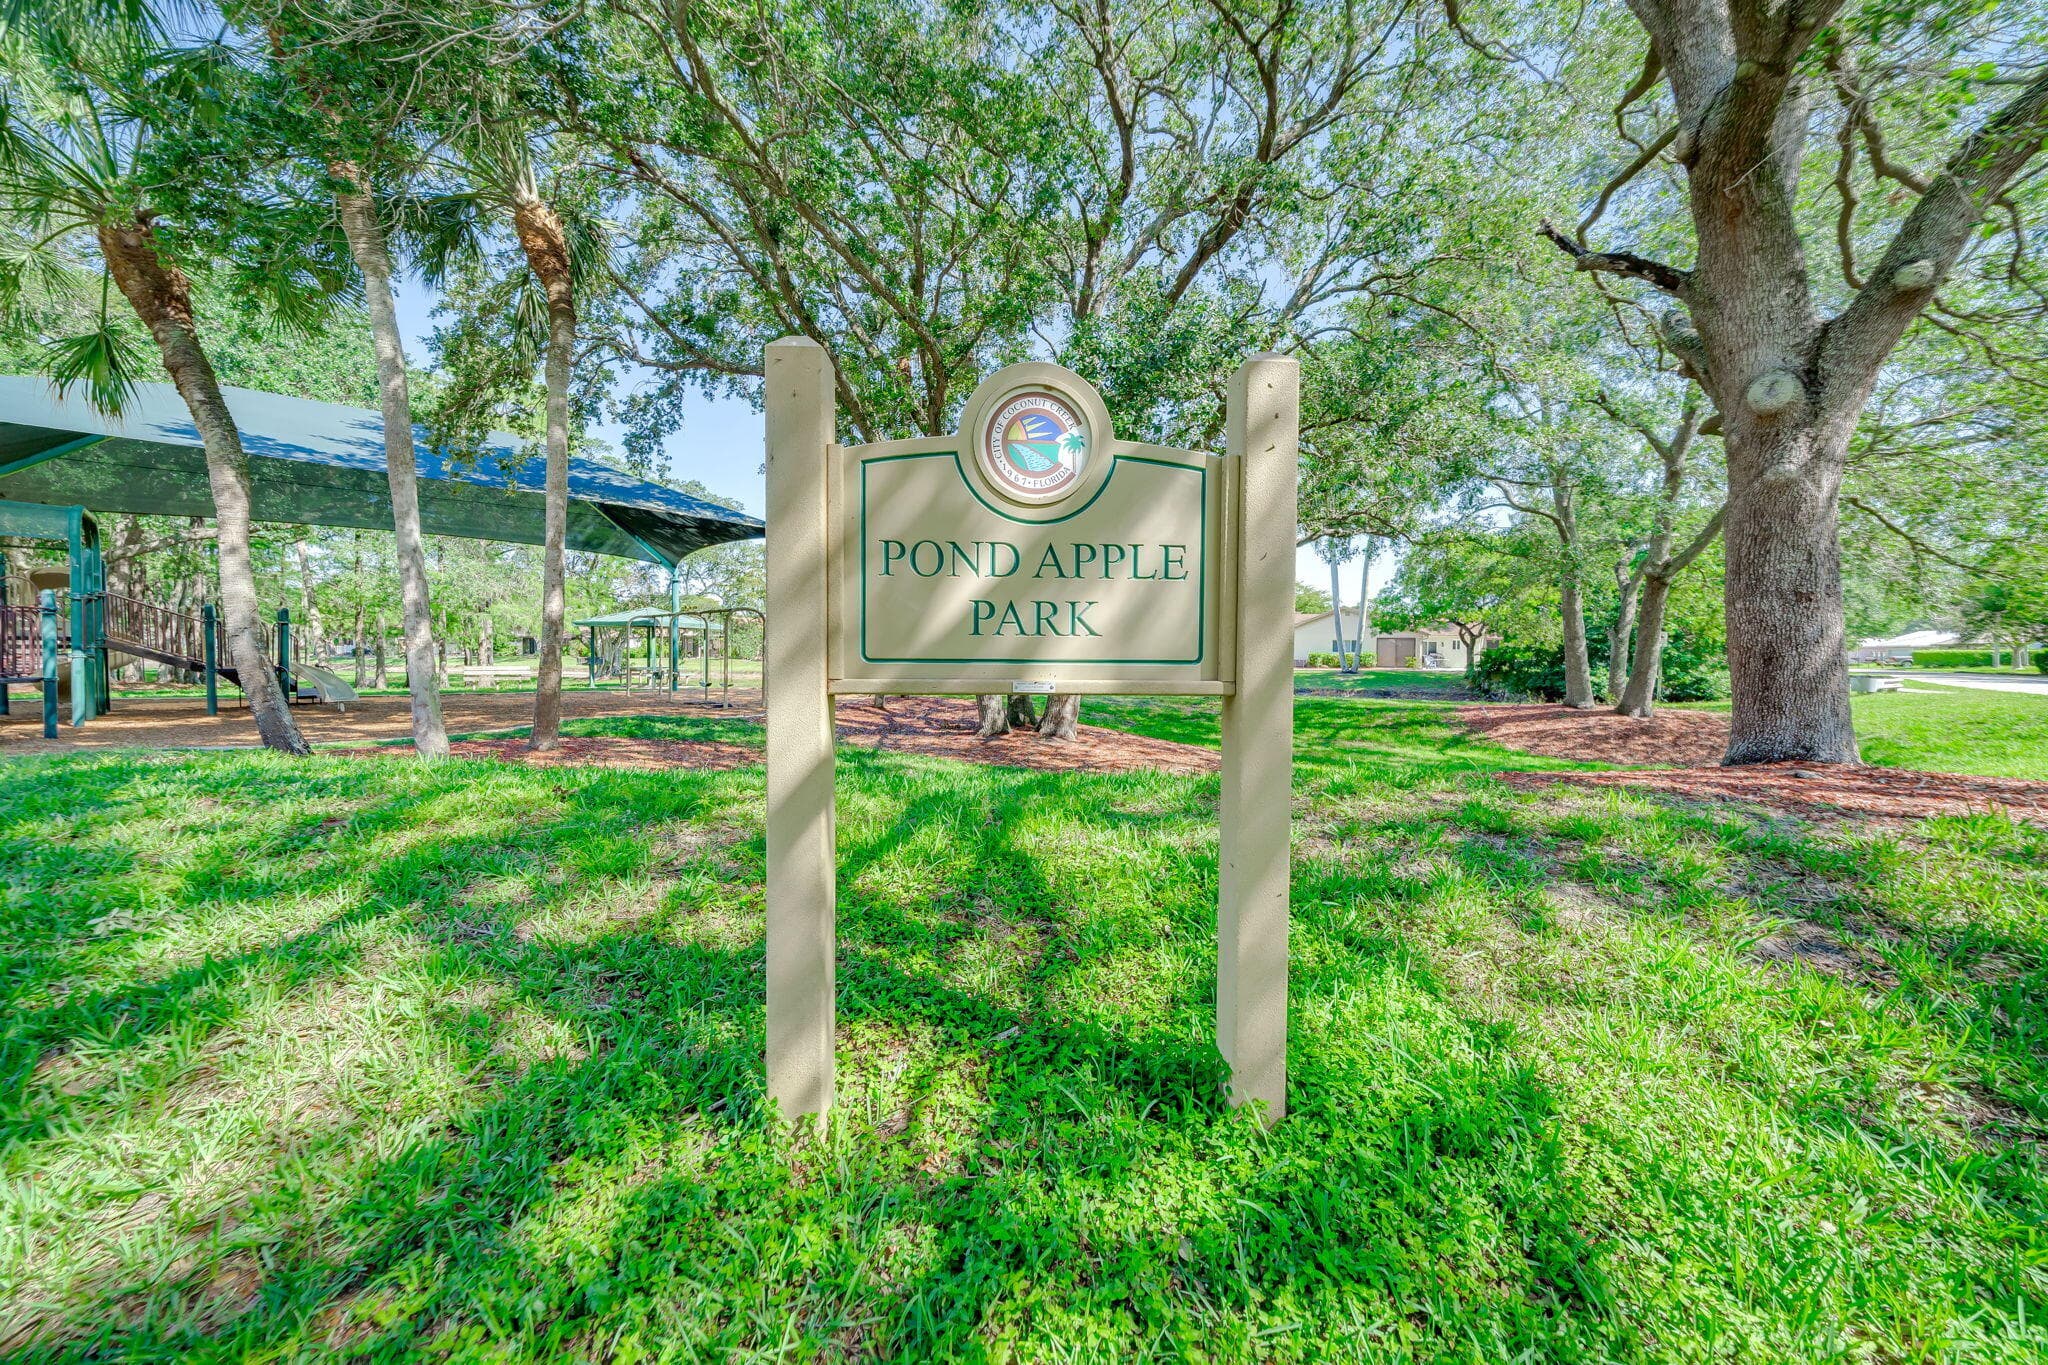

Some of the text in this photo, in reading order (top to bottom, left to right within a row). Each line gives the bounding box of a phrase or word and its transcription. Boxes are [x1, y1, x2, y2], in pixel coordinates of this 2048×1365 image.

[992, 398, 1078, 459] CITY OF COCONUT CREEK
[1033, 466, 1072, 488] FLORIDA
[878, 539, 1190, 581] POND APPLE
[968, 599, 1103, 638] PARK
